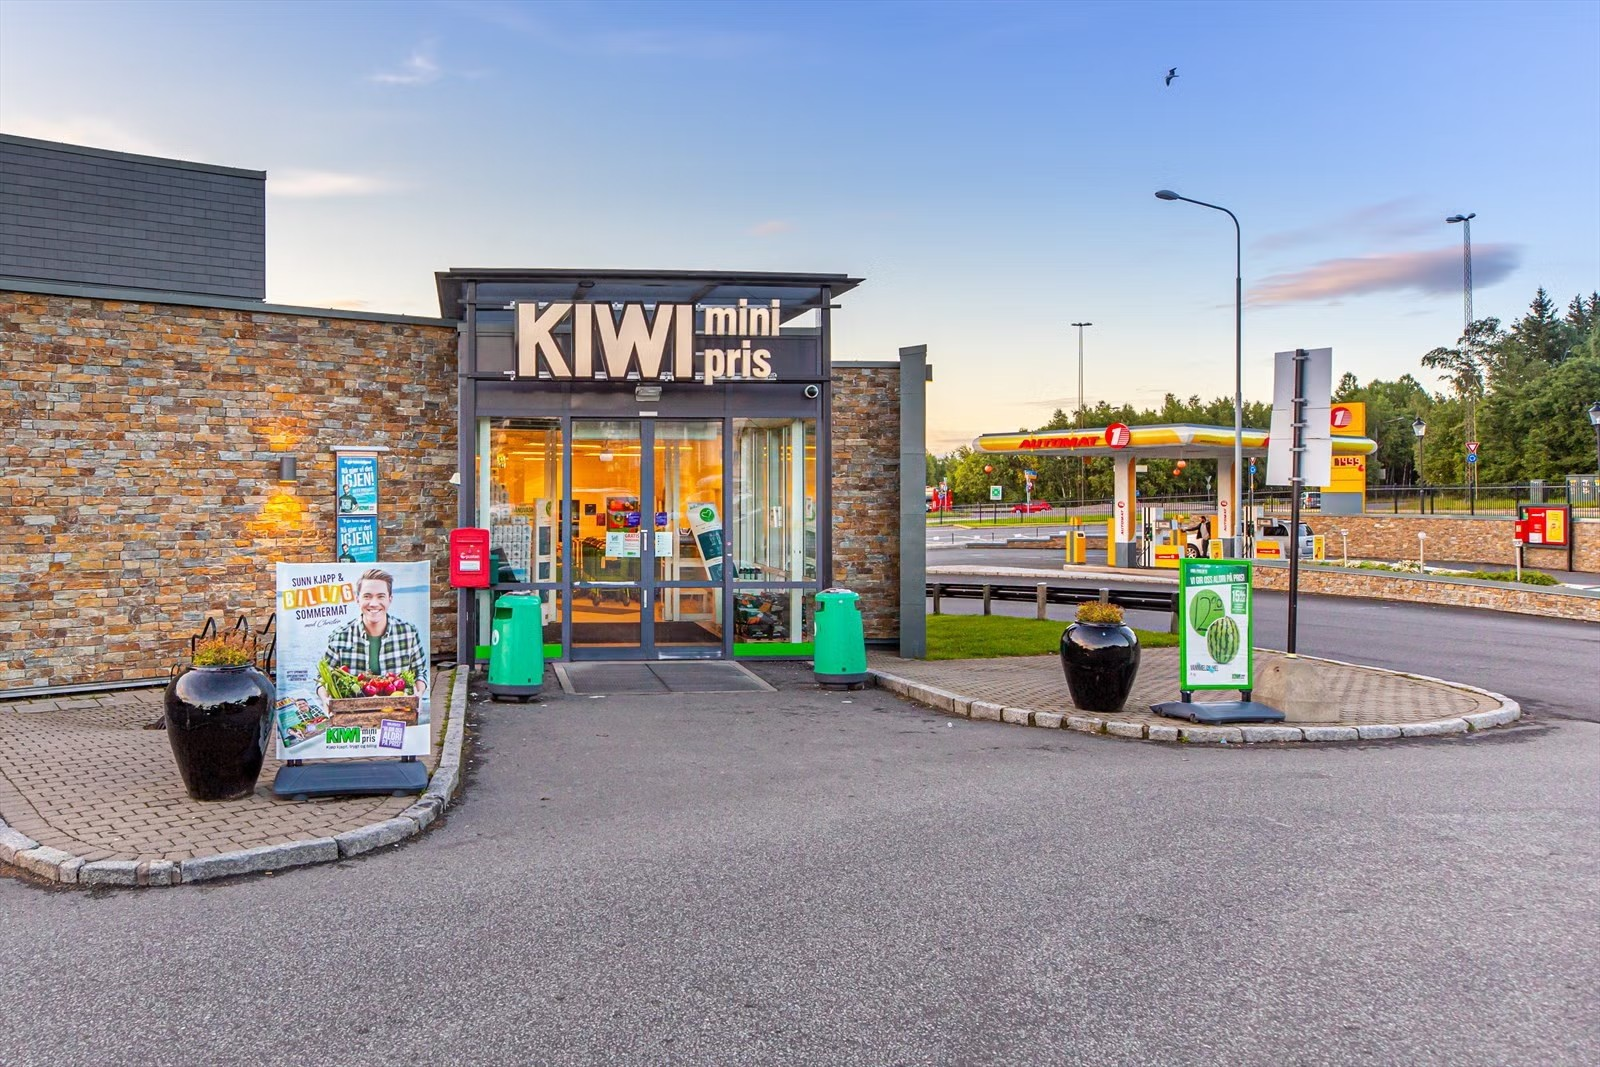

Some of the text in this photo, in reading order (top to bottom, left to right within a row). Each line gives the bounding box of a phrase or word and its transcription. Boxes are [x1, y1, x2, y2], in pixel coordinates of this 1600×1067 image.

[704, 298, 781, 336] mini
[516, 301, 695, 379] KIWI
[704, 339, 772, 386] pris
[1018, 436, 1100, 449] AUTOMAT
[341, 472, 374, 487] IGJEN!
[340, 531, 373, 547] IGJEN!
[292, 573, 344, 587] SUNN KJAPP &
[284, 584, 353, 608] BILLIG
[295, 605, 348, 620] SOMMERMAT
[326, 727, 360, 743] KIWI
[362, 735, 376, 744] pris
